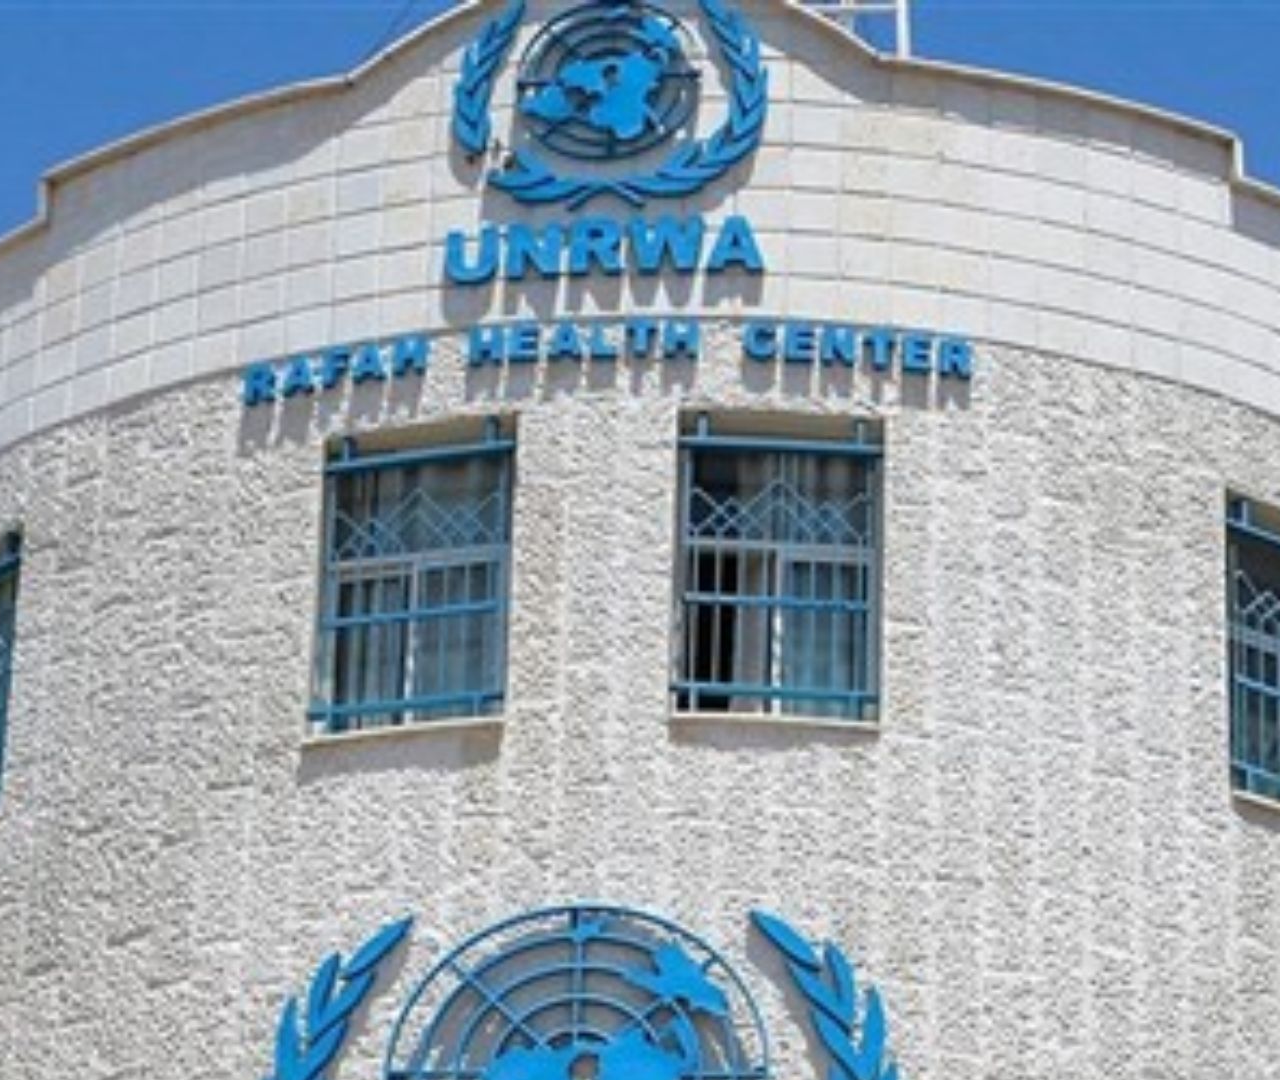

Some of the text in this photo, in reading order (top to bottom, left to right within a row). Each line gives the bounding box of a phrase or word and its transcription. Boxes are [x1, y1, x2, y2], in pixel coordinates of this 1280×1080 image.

[443, 214, 765, 286] UNRWA
[243, 315, 974, 407] RAFAH HEALTH CENTER
